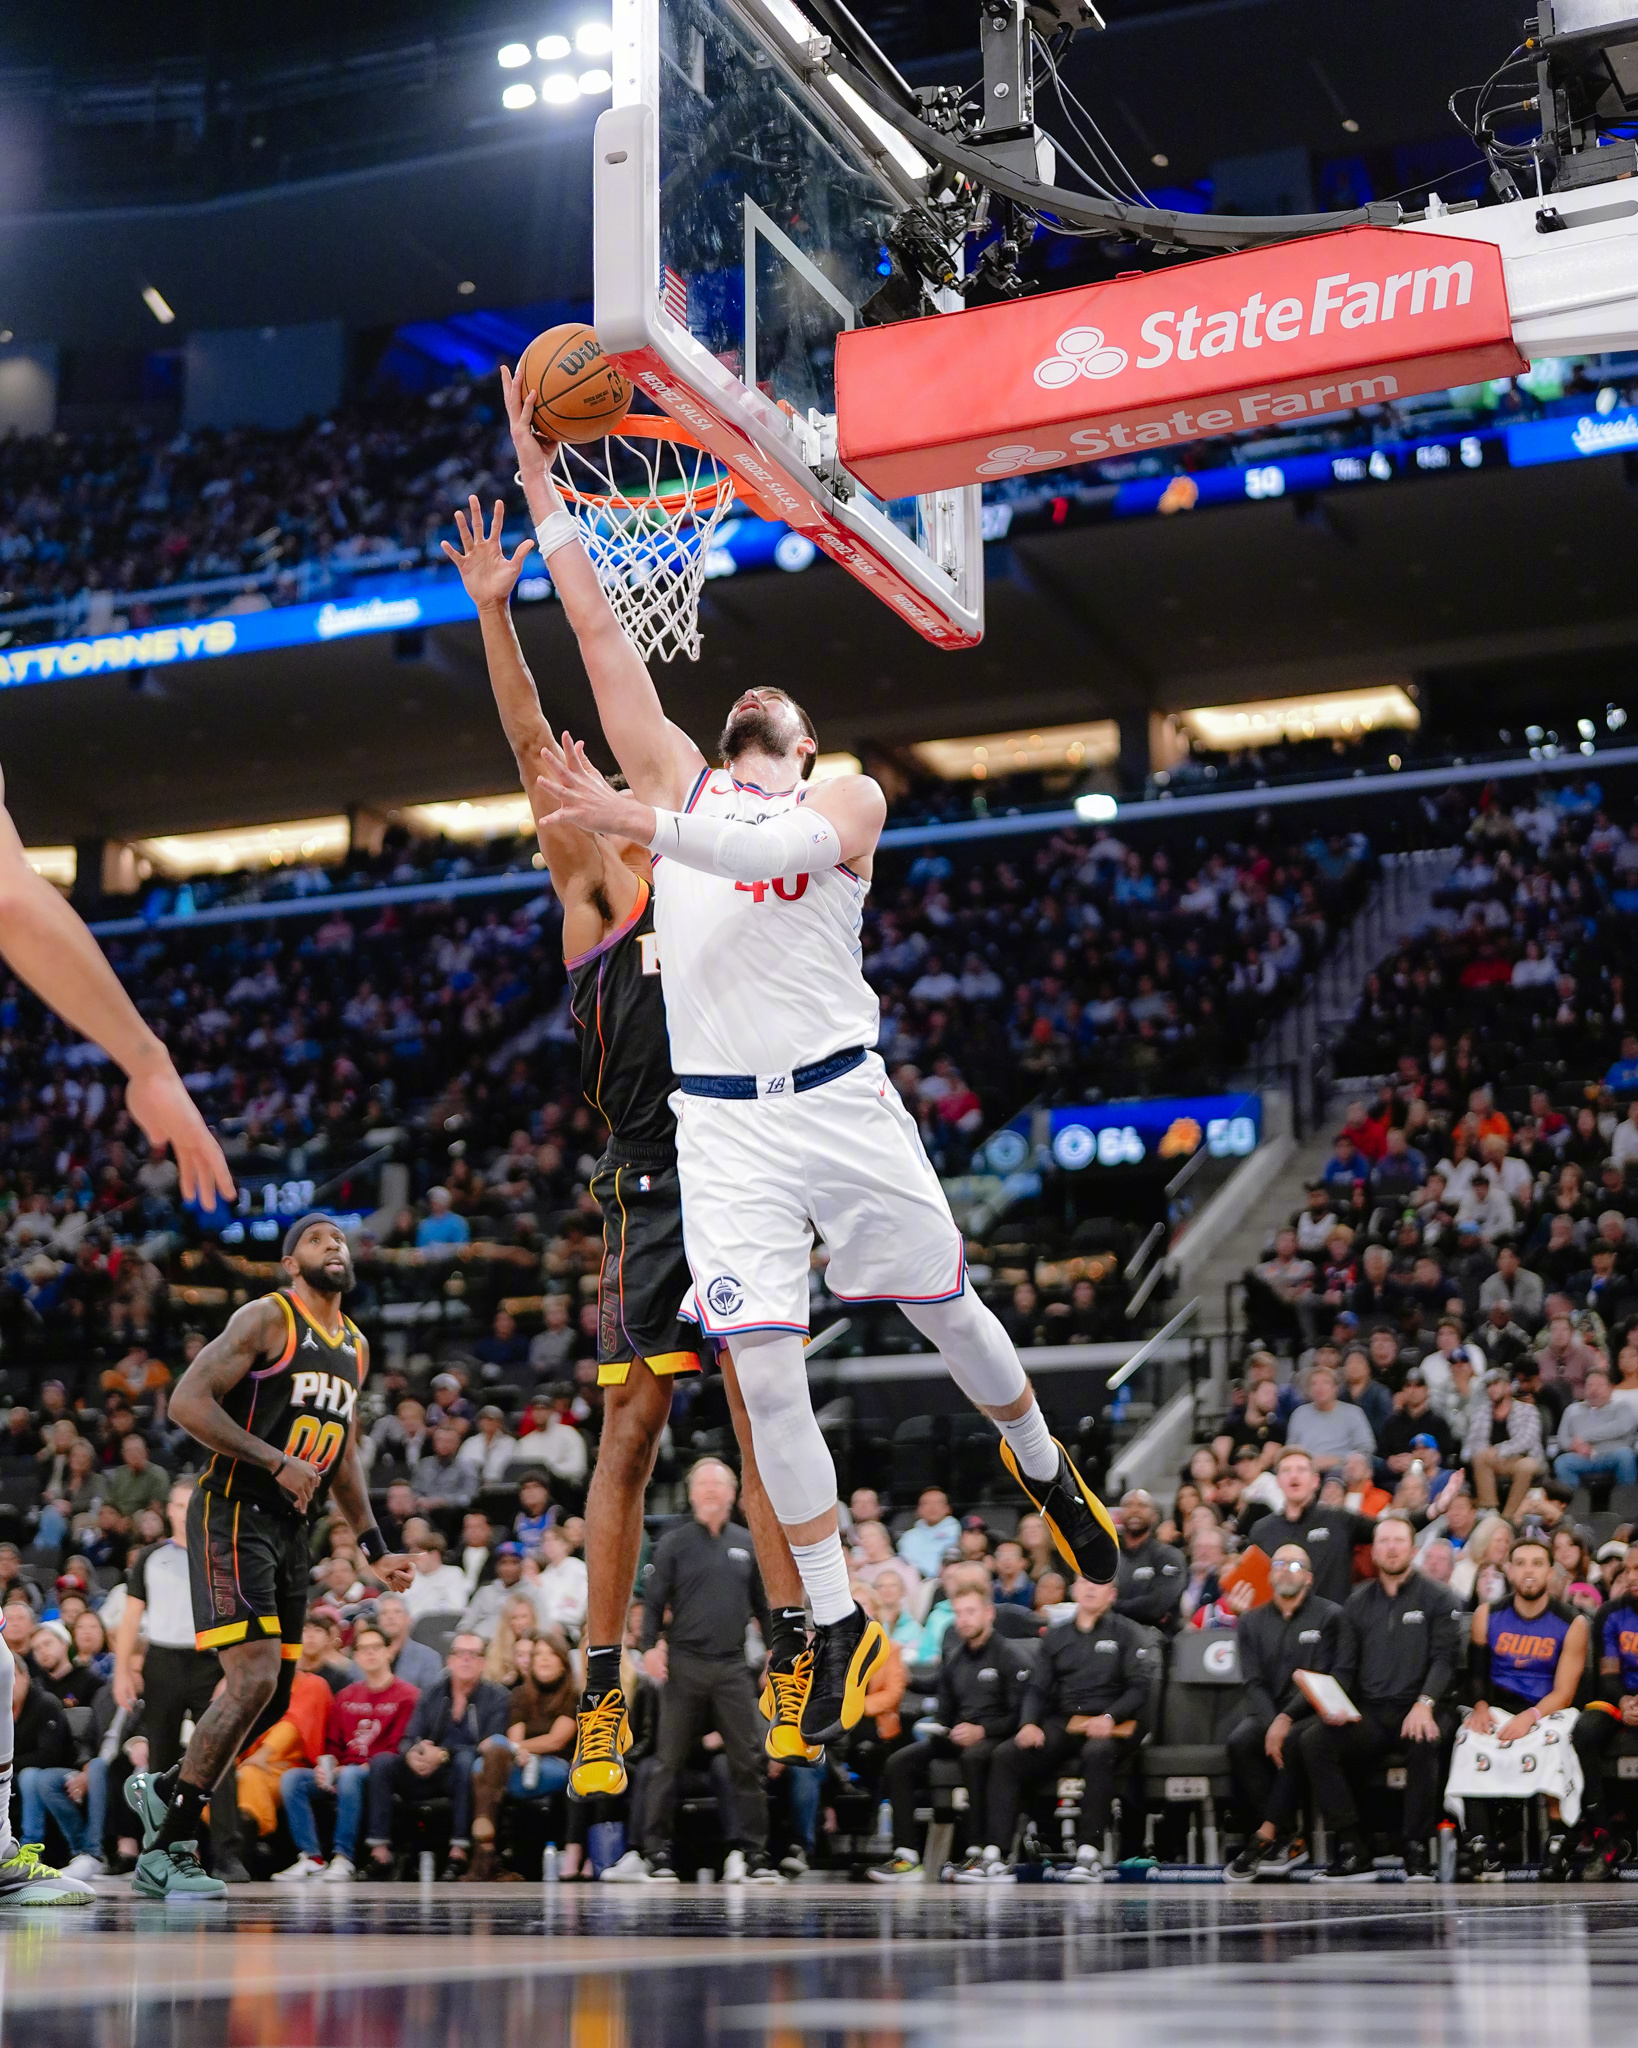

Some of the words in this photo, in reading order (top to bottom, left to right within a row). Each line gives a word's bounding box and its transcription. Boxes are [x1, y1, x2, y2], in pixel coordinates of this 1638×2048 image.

[1136, 292, 1303, 370] State
[1309, 260, 1474, 336] Farm
[637, 371, 680, 404] HERDEZ
[674, 400, 714, 431] SALSA
[1069, 409, 1233, 456] State
[1239, 375, 1398, 424] Farm
[732, 452, 773, 483] HERDEZ
[765, 482, 800, 511] SALSA
[1244, 466, 1285, 499] 50
[817, 532, 855, 555] HERDEZ
[845, 553, 878, 576] SALSA
[891, 593, 925, 619] HERDEZ
[917, 616, 948, 638] SALSA
[290, 1371, 358, 1423] PHX
[284, 1414, 345, 1475] 00
[1494, 1631, 1556, 1661] SUNS
